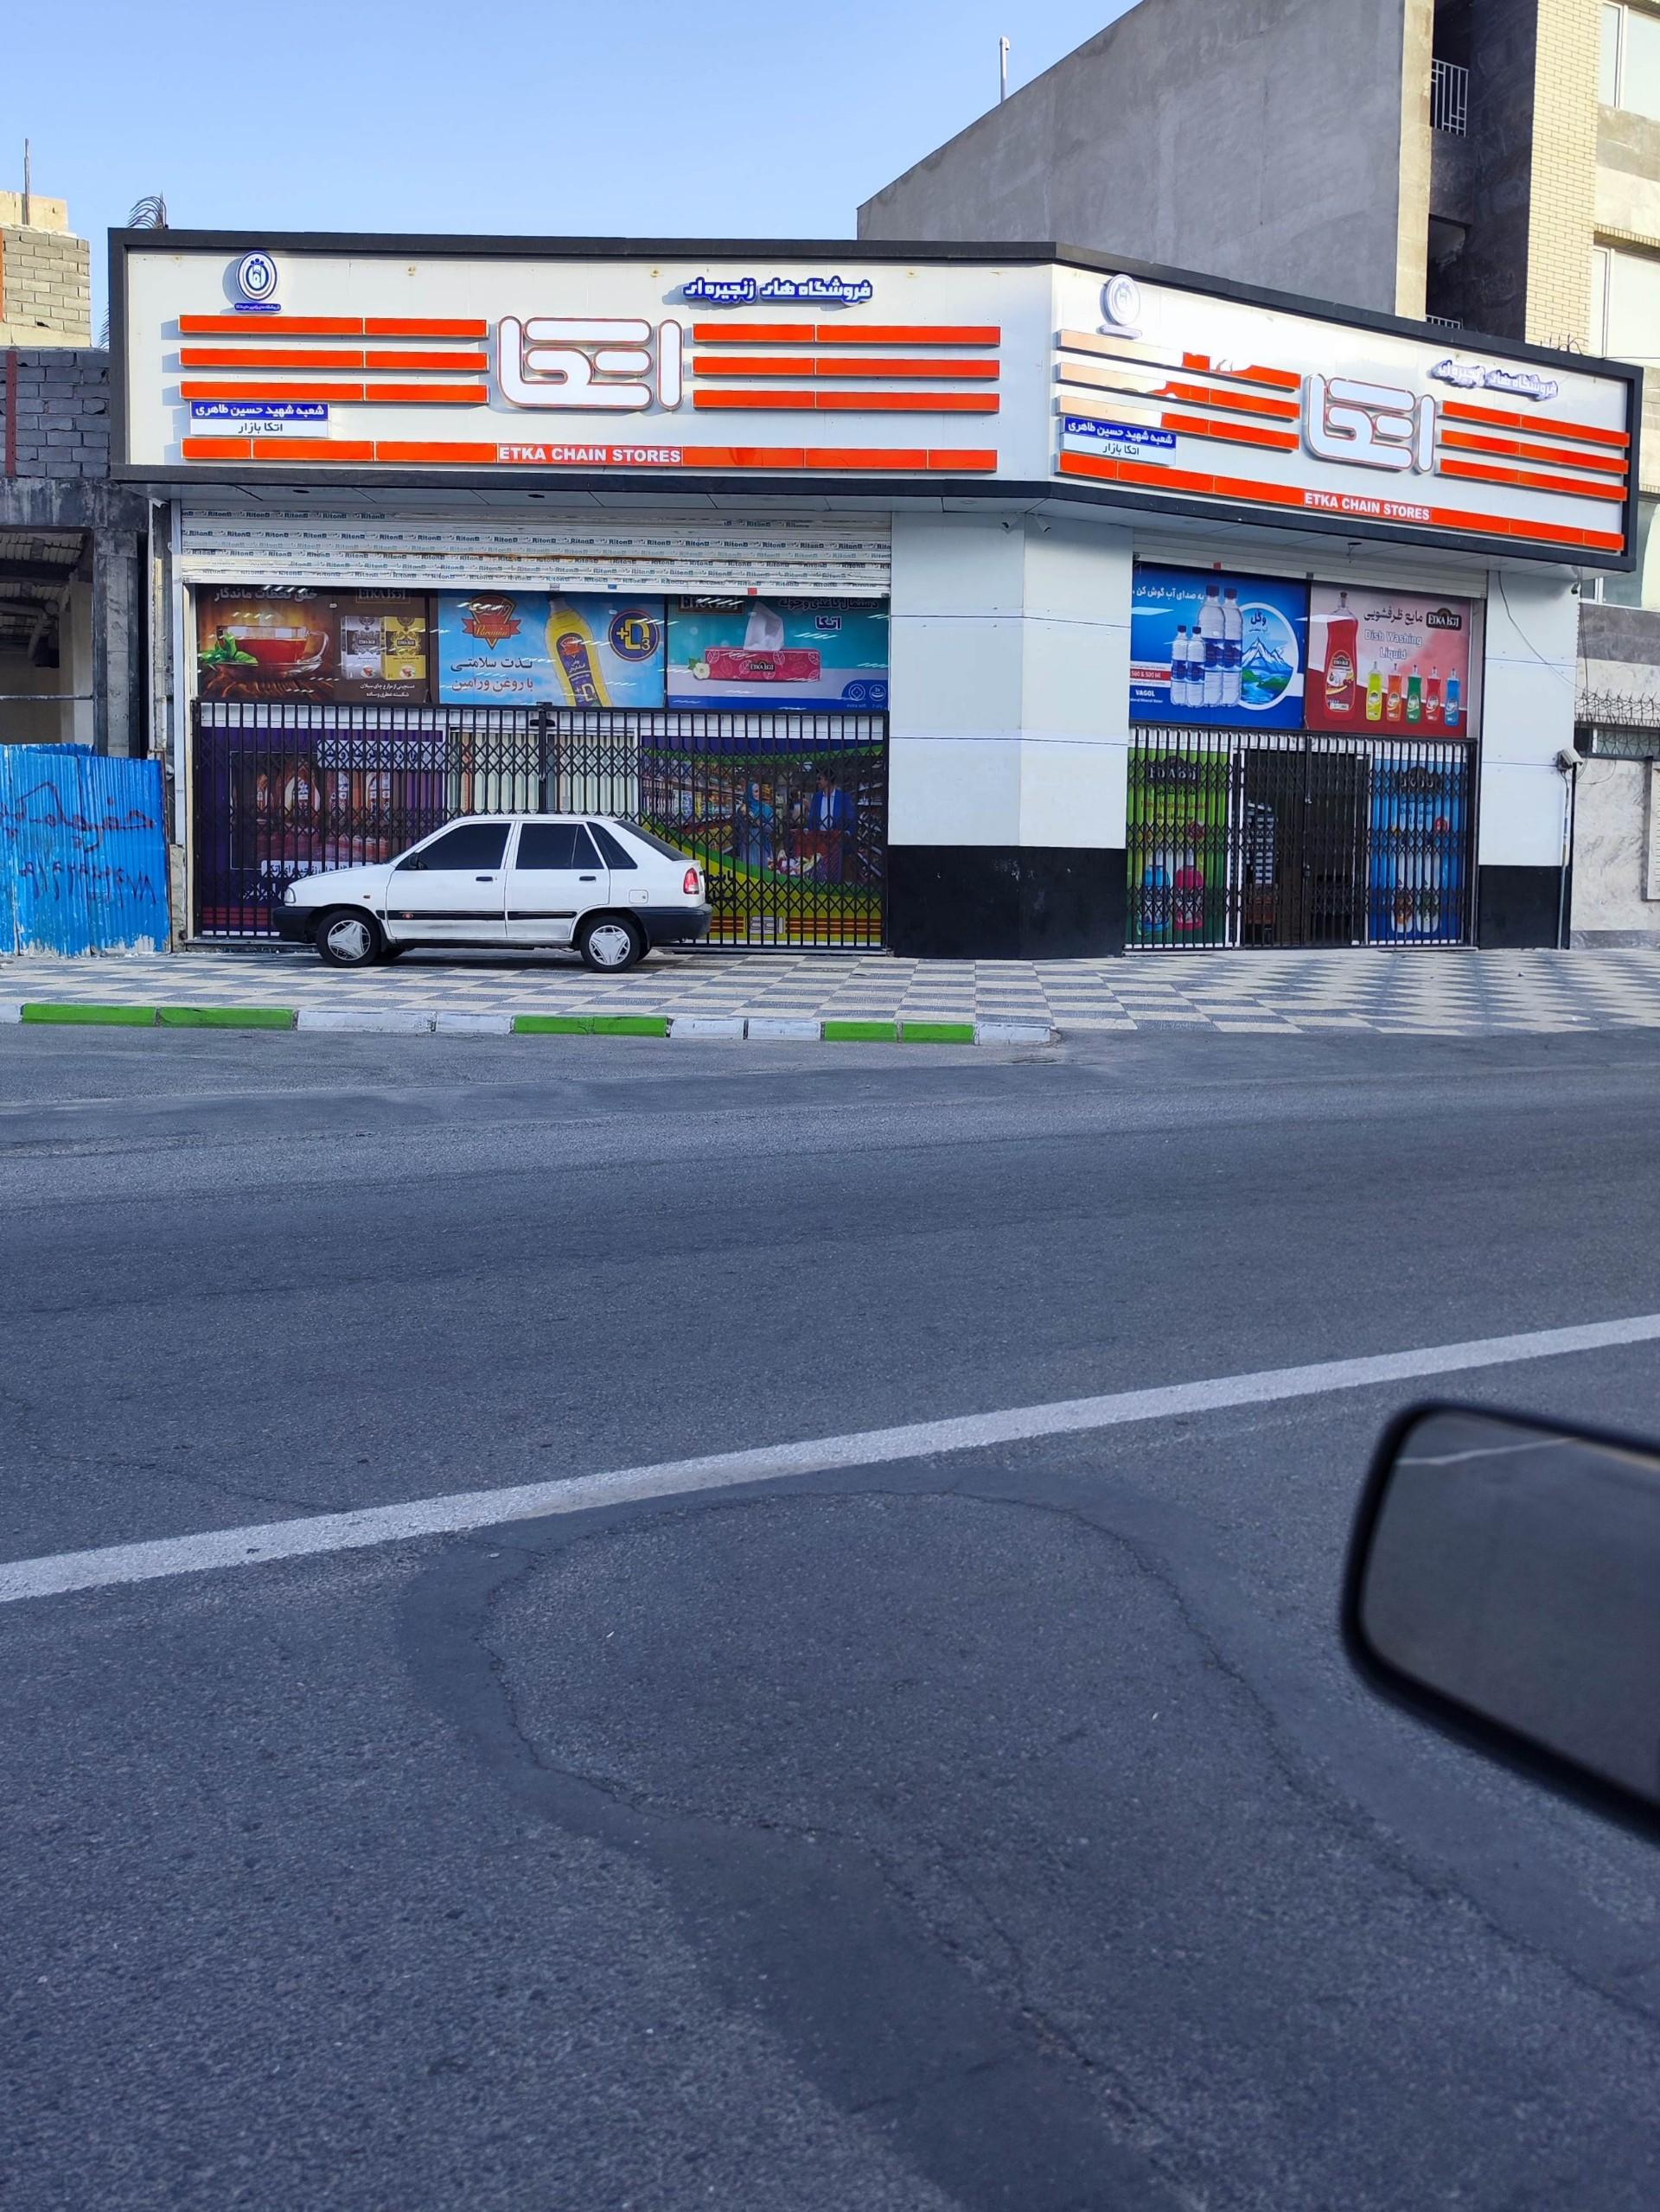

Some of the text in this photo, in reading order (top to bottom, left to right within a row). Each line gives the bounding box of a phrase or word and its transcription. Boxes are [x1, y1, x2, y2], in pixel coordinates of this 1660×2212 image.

[704, 278, 755, 300] زنجیره
[761, 278, 795, 296] های
[798, 276, 872, 301] فروشگاه
[195, 404, 324, 418] شعبه شهید حسین طاهری
[238, 422, 283, 433] اتکا بازار
[1068, 422, 1172, 444] شعبه شهید حسین طاهری
[499, 447, 681, 462] ETKA CHAIN STORES
[1102, 443, 1140, 456] اتکا بازار
[1305, 492, 1430, 520] ETKA CHAIN STORES
[214, 587, 252, 602] ماندگار
[1165, 588, 1176, 600] آب
[815, 615, 842, 630] اتکا
[1405, 610, 1423, 626] مایع
[1365, 629, 1423, 647] Dish Washing
[1380, 647, 1407, 661] Liquid
[450, 657, 497, 672] سلامتی
[493, 677, 524, 692] روغن
[527, 677, 533, 692] با
